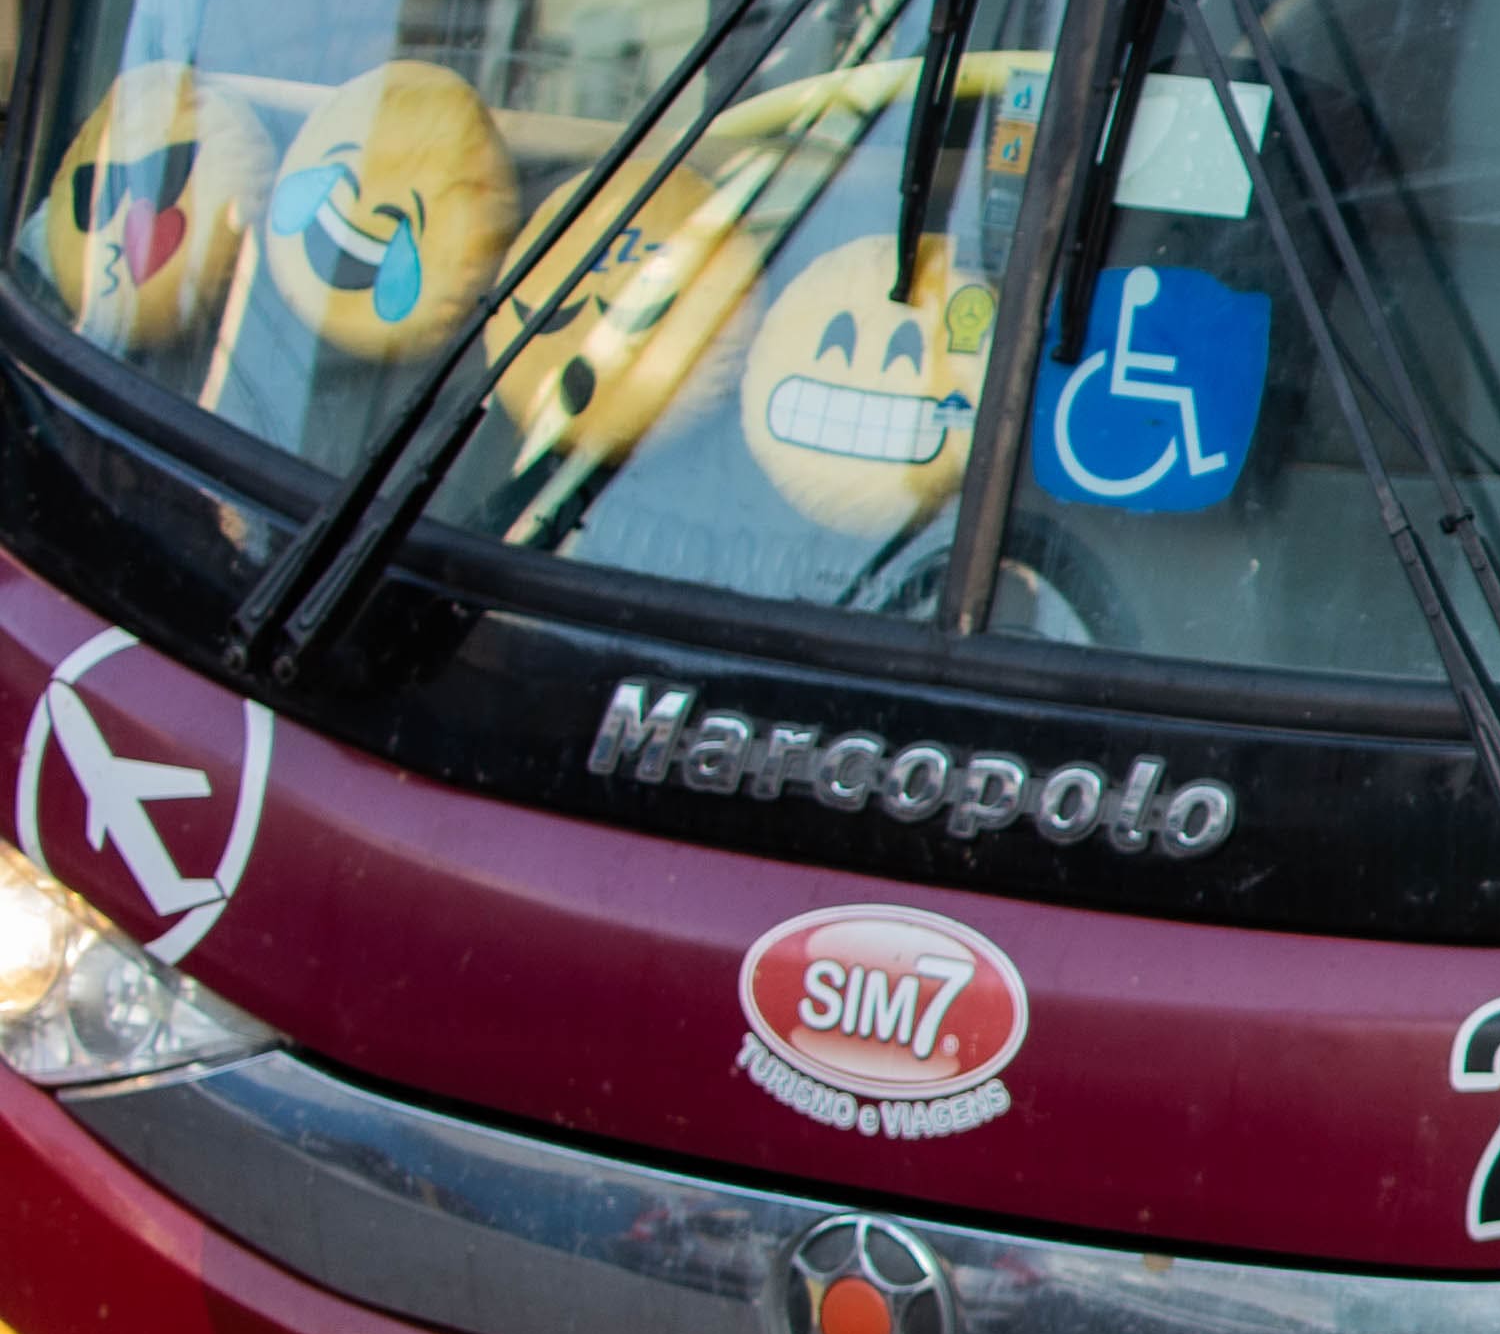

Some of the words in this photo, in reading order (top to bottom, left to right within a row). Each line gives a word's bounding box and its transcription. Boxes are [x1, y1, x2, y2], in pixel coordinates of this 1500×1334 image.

[589, 676, 1236, 858] Marcopolo
[738, 1033, 858, 1130] TURISMO
[880, 1079, 1011, 1140] VIAGENS
